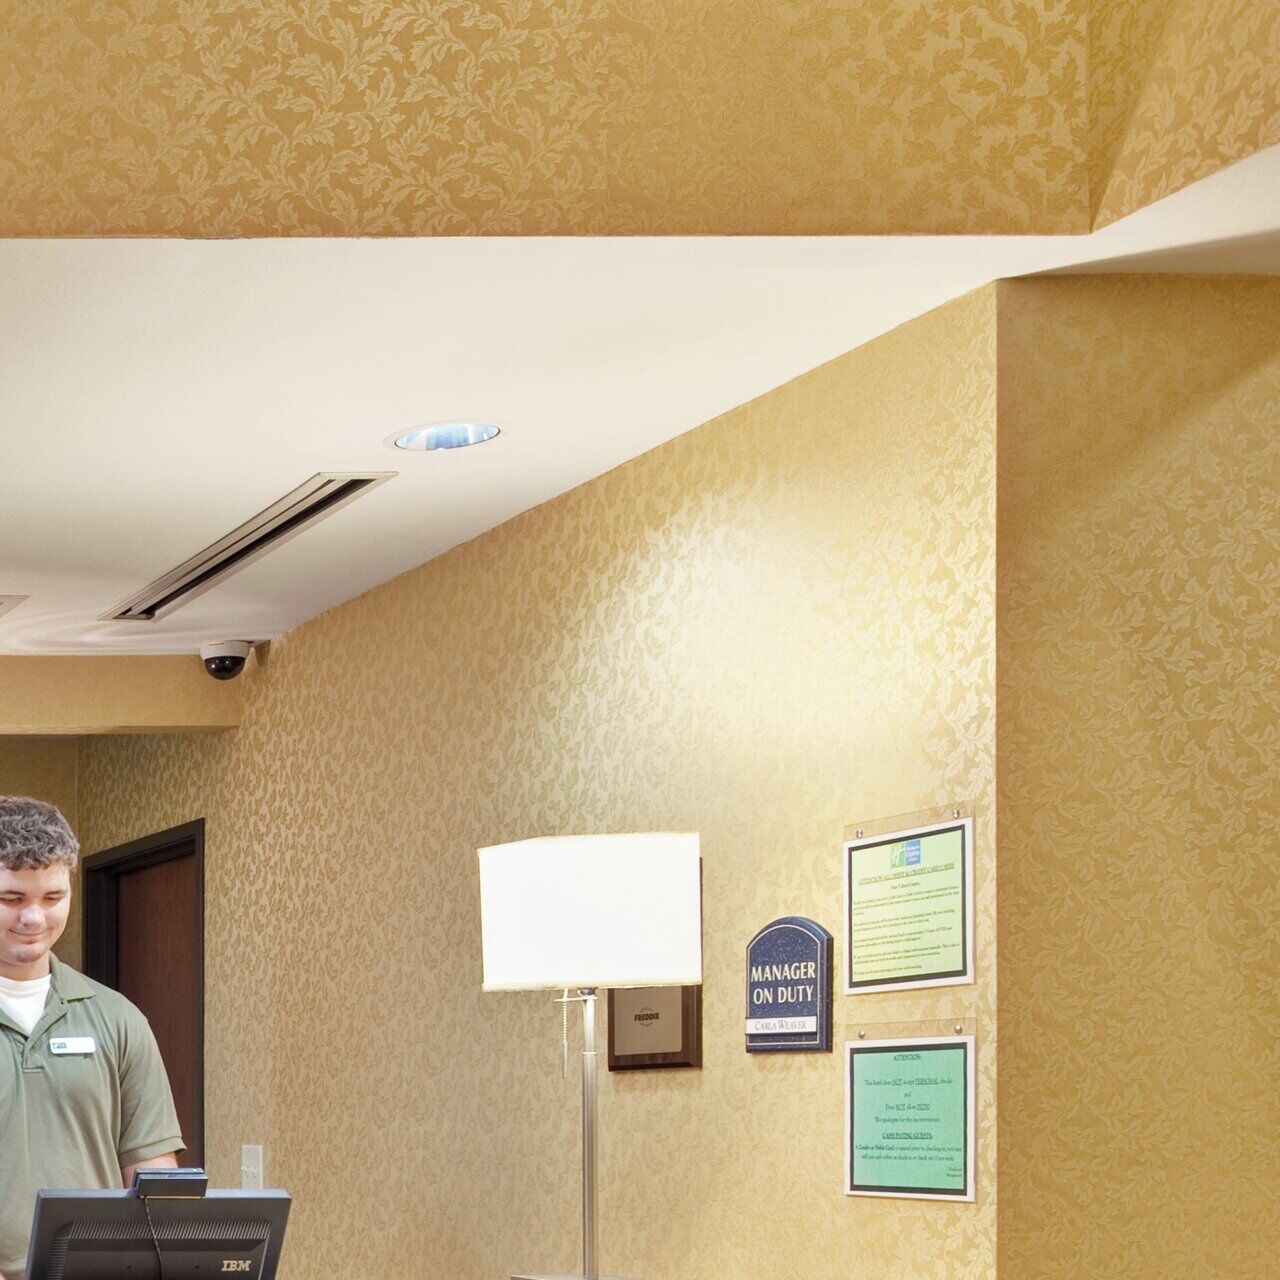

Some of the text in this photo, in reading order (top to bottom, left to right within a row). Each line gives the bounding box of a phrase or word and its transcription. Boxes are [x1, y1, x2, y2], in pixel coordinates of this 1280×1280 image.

[751, 962, 816, 982] MANAGER
[753, 985, 814, 1005] ON DUTY
[221, 1260, 251, 1271] IBM
